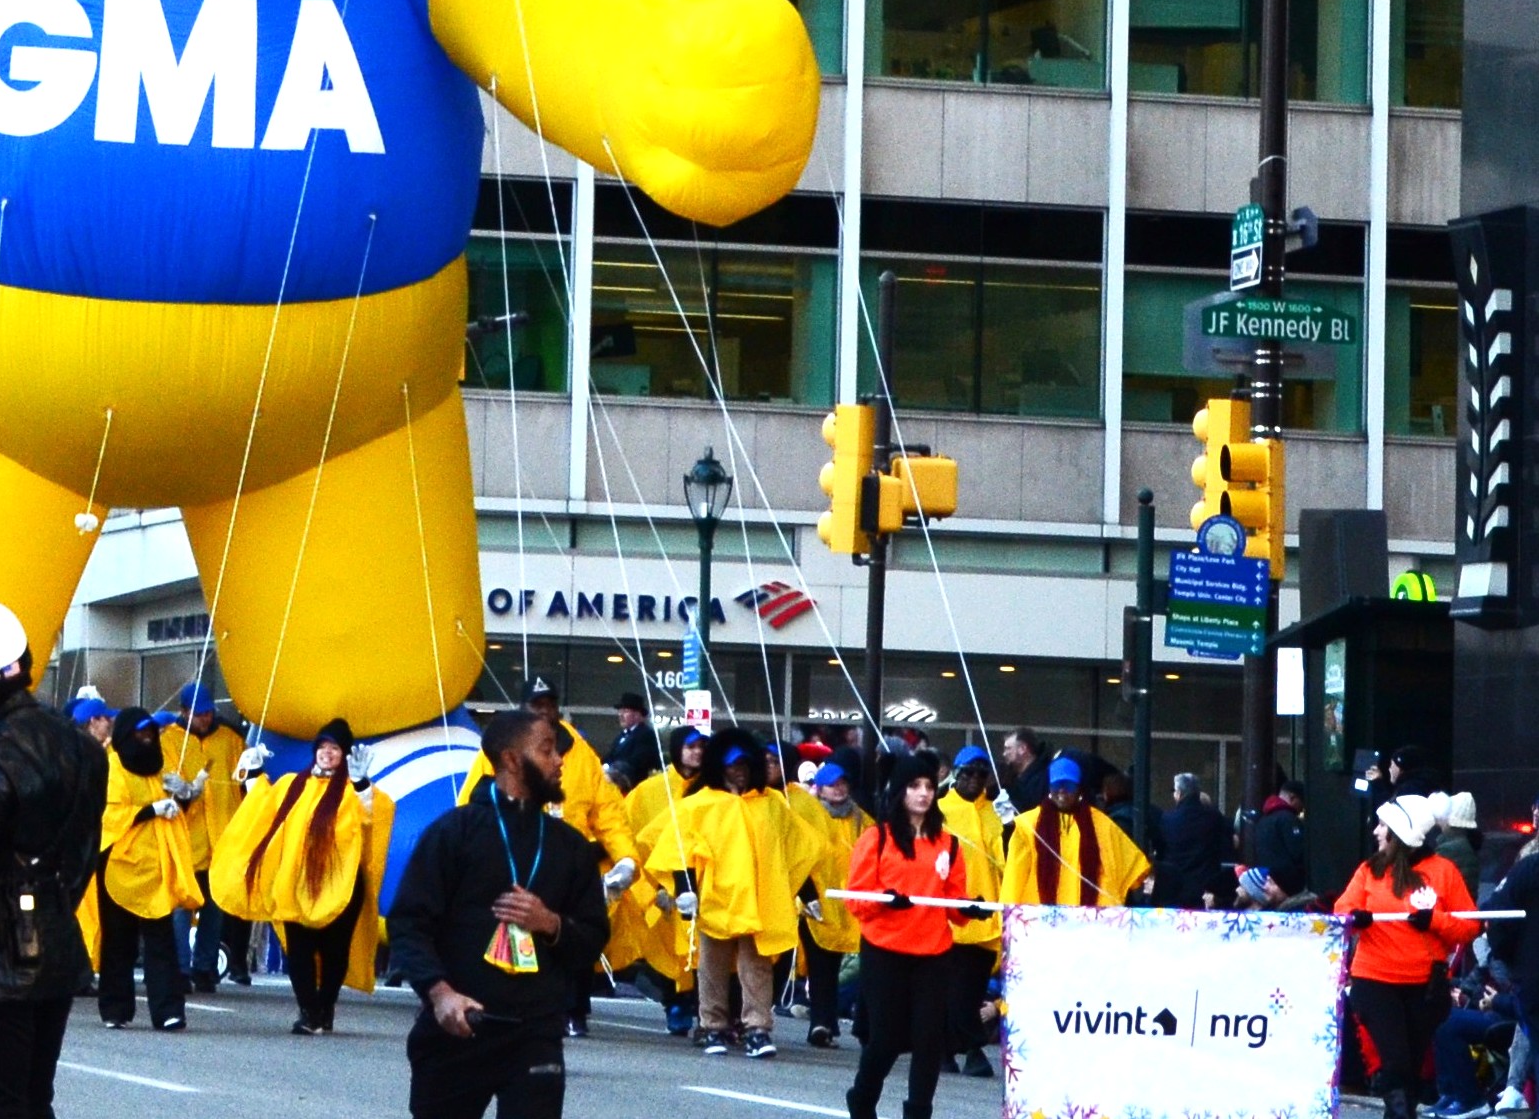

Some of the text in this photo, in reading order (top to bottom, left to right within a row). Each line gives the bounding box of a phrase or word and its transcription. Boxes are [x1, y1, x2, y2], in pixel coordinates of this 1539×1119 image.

[1272, 301, 1286, 313] W
[1208, 311, 1350, 342] JF Kennedy Bl
[487, 588, 536, 616] OF
[655, 670, 684, 689] 160
[1210, 1014, 1269, 1049] nrg
